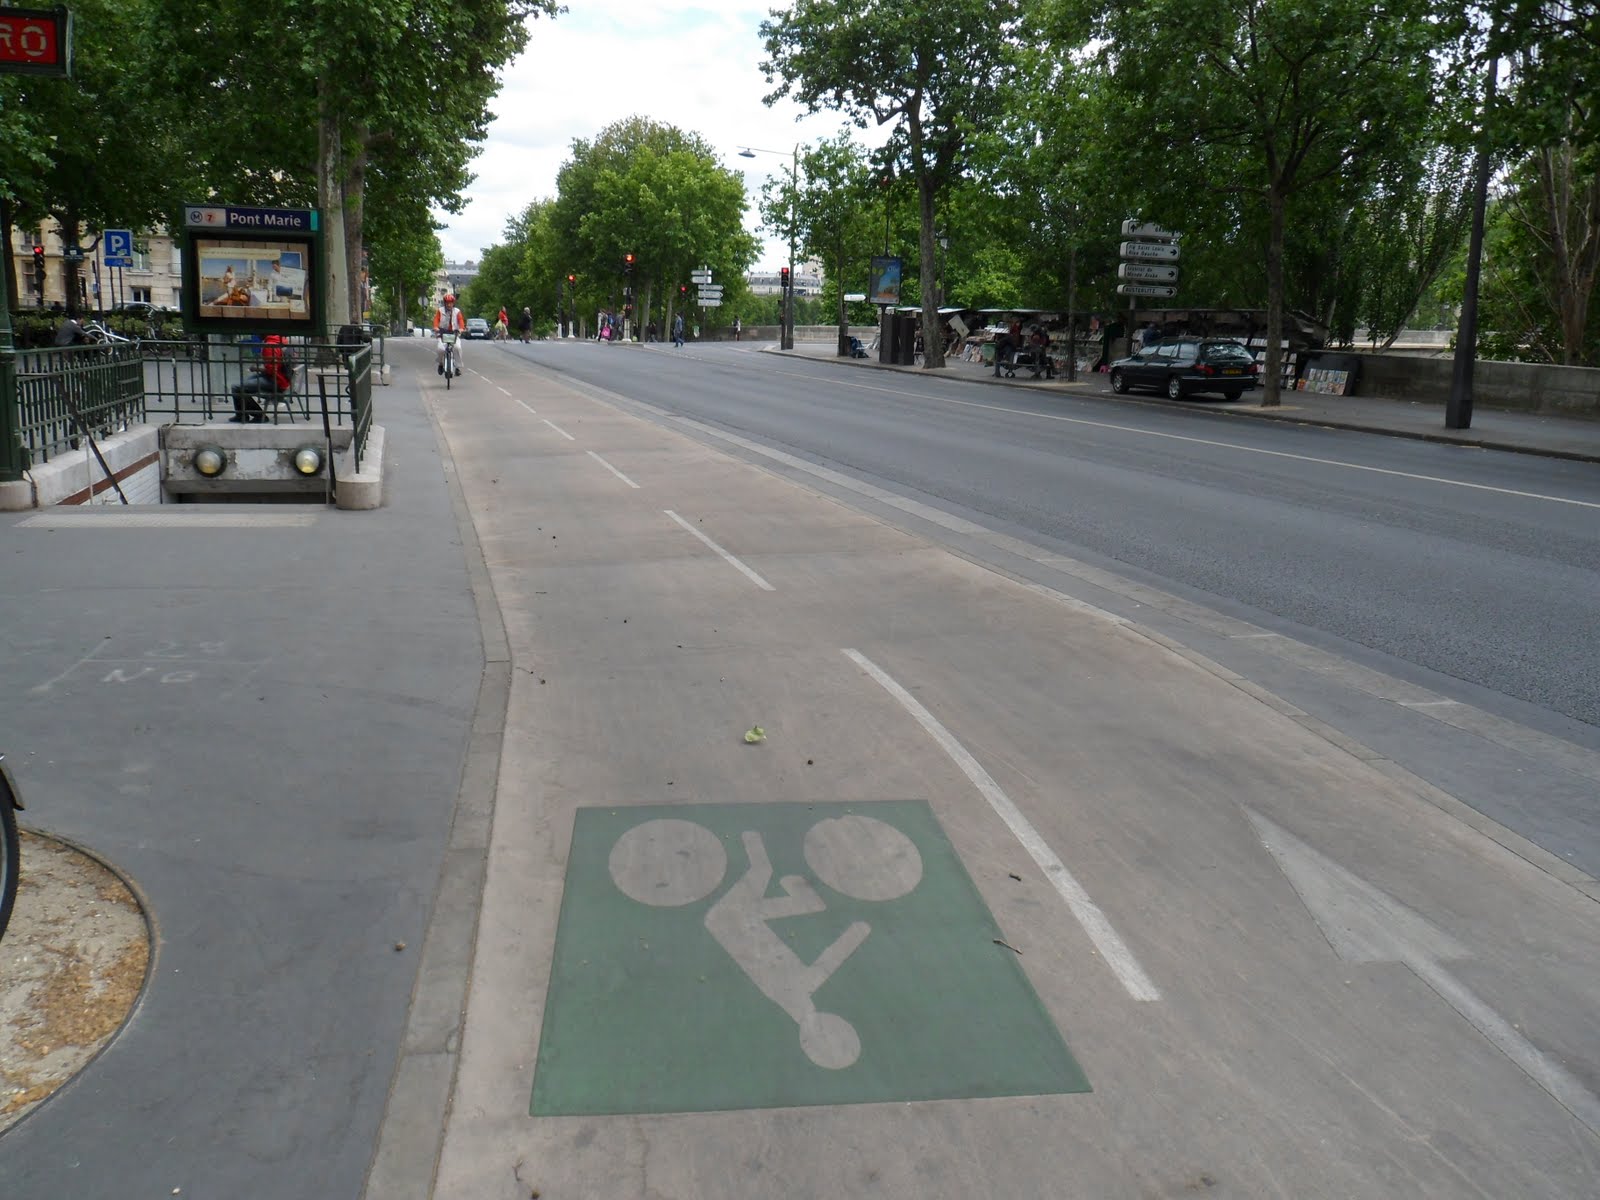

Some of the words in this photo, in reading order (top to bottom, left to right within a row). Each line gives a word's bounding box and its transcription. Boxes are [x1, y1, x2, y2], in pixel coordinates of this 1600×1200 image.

[207, 214, 213, 222] 7
[230, 212, 261, 225] Pont
[264, 214, 301, 226] Marie
[111, 235, 124, 252] P
